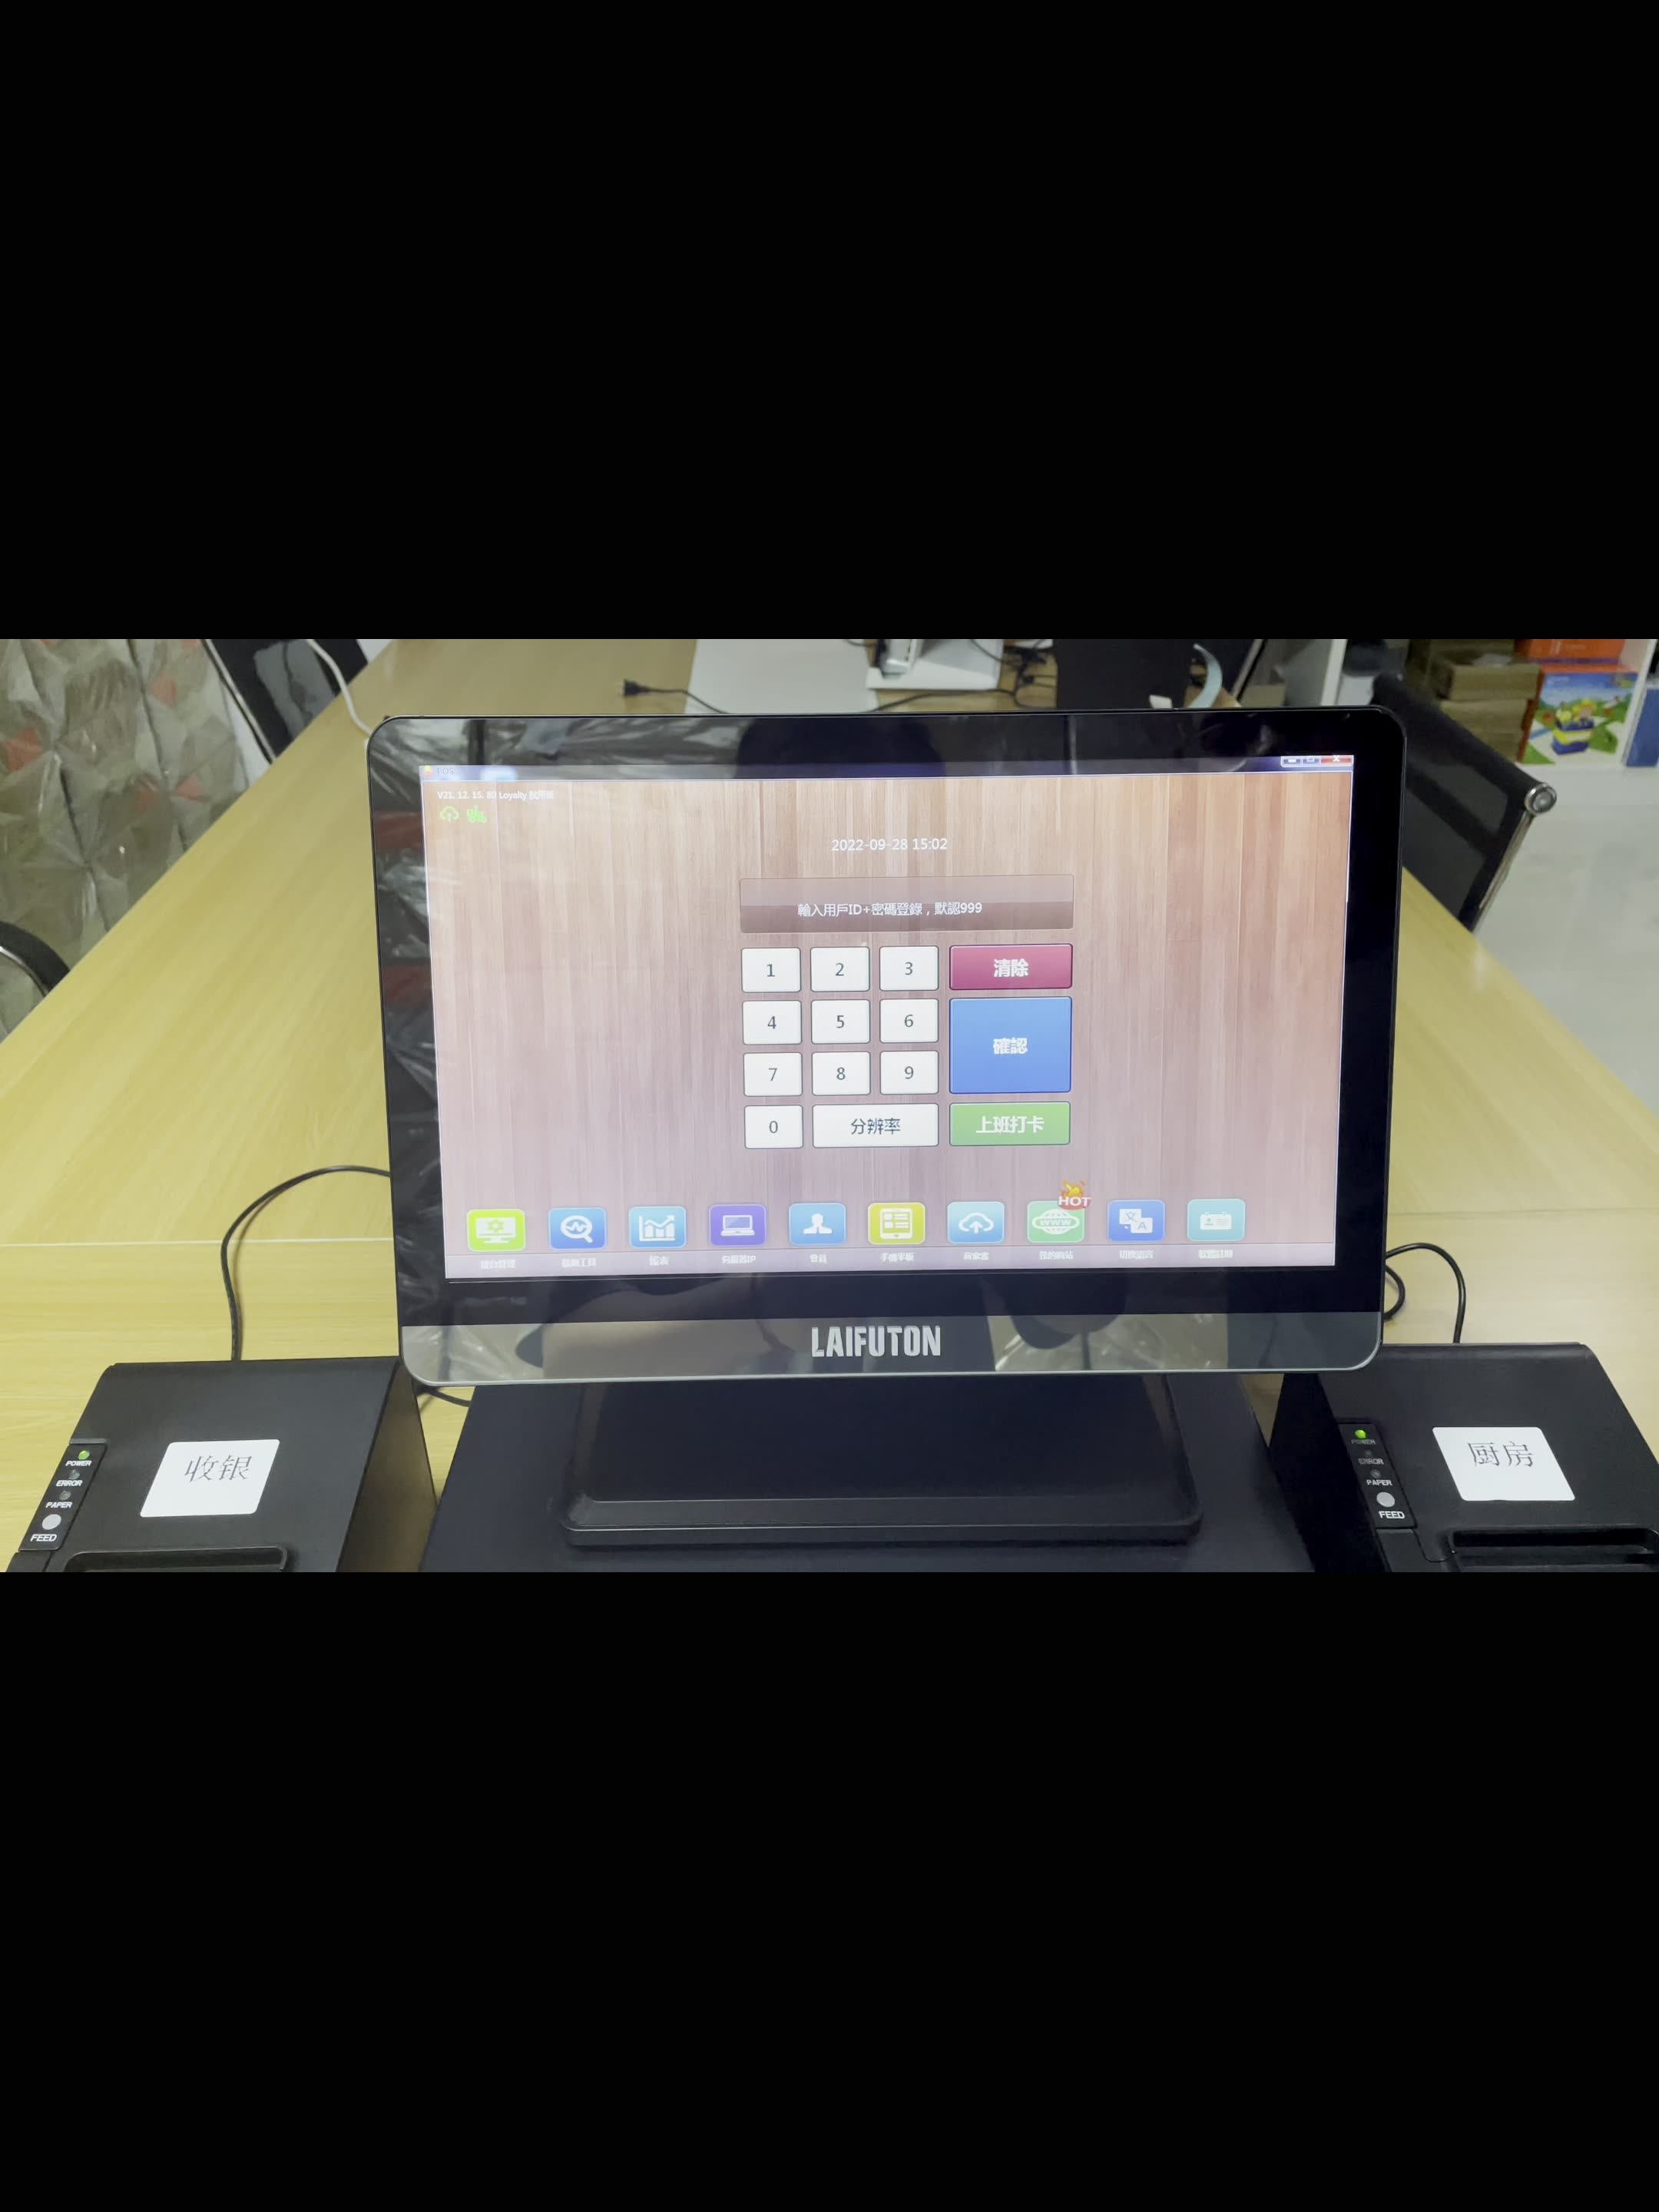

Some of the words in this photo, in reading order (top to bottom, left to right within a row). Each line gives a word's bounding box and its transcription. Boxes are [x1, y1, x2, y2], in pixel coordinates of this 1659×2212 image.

[498, 790, 527, 800] Loyalty
[831, 839, 908, 851] 2022-09-28
[912, 838, 947, 850] 15:02
[767, 963, 776, 977] 1
[835, 962, 845, 976] 2
[904, 962, 913, 975] 3
[993, 959, 1029, 978] 清除
[767, 1015, 777, 1030] 4
[836, 1015, 845, 1028] 5
[904, 1014, 914, 1028] 6
[992, 1037, 1028, 1055] 確認
[768, 1068, 777, 1081] 7
[836, 1067, 846, 1081] 8
[904, 1065, 914, 1079] 9
[769, 1120, 778, 1134] 0
[850, 1117, 901, 1136] 分辨率
[975, 1115, 1045, 1134] 上班打卡
[1058, 1196, 1091, 1207] HOT
[811, 1325, 941, 1357] LAIFUTON
[1467, 1440, 1534, 1468] 厨房
[184, 1454, 253, 1482] 收银
[1379, 1510, 1406, 1519] FEED
[30, 1533, 58, 1542] FEED
